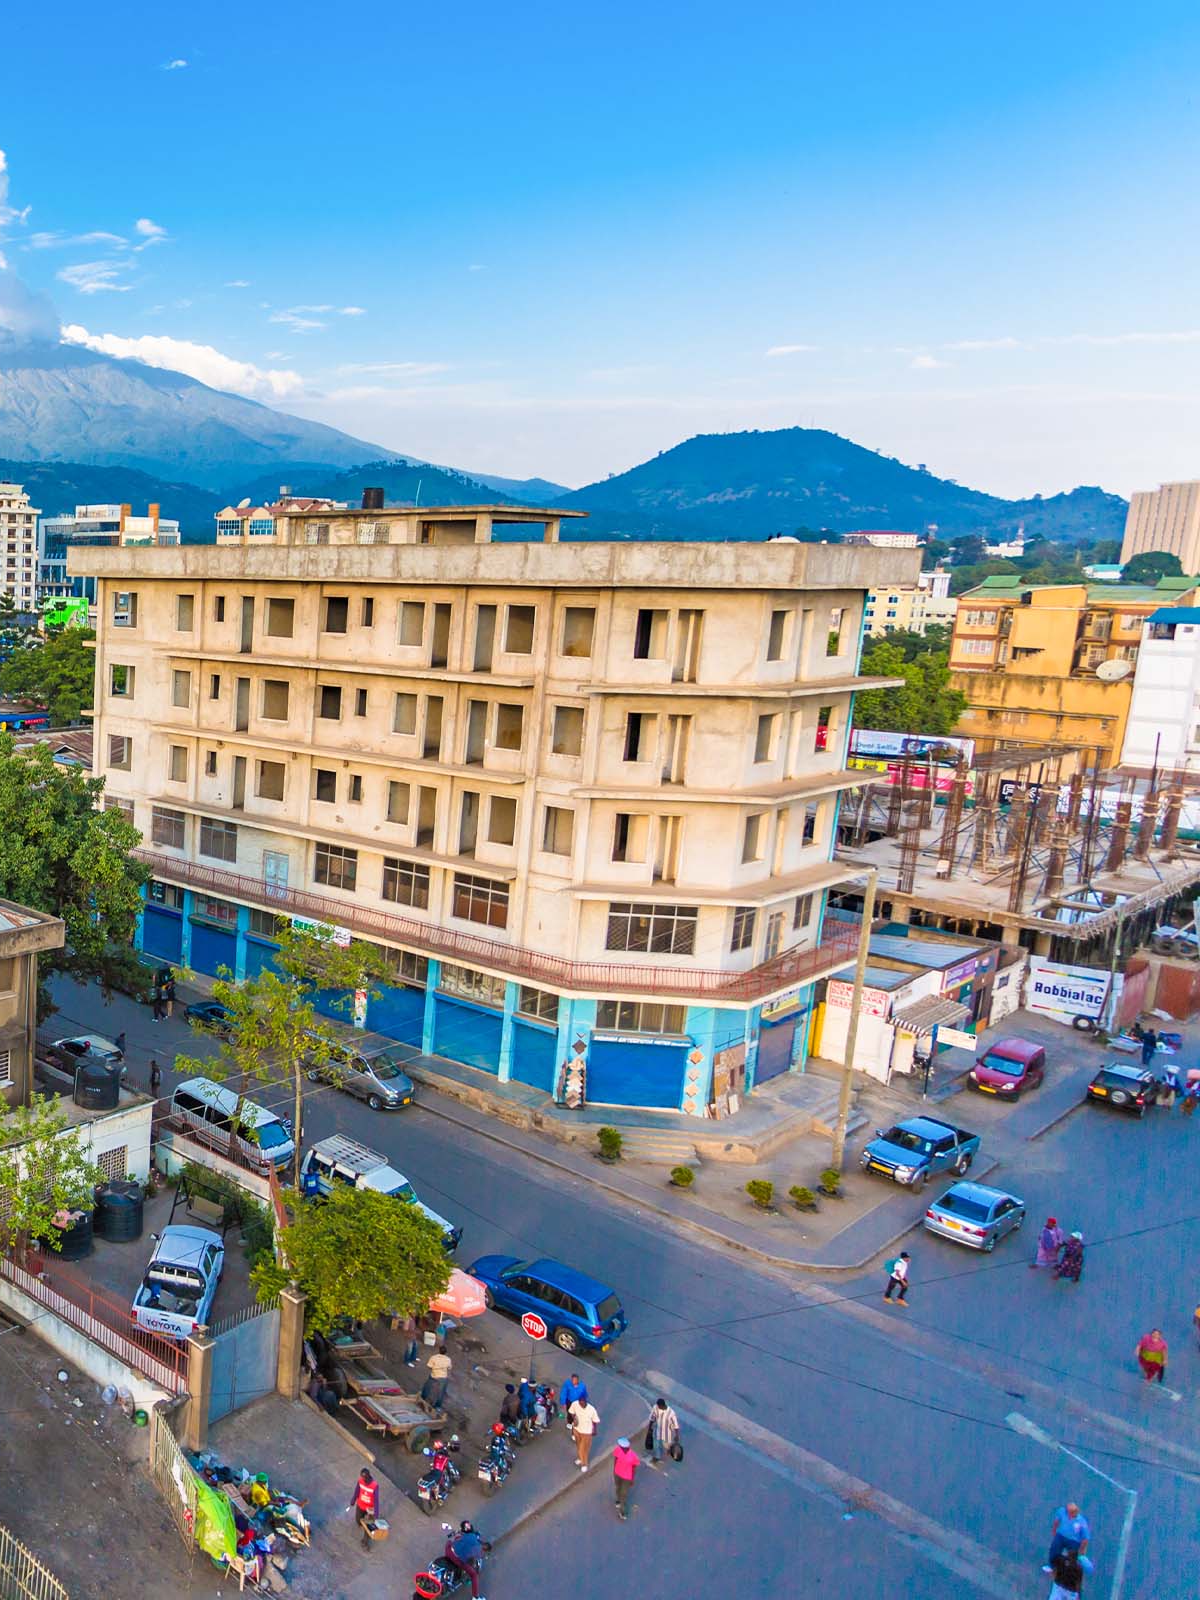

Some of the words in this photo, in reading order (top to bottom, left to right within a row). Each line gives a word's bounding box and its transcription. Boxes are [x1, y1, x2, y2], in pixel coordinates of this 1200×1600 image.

[1034, 982, 1103, 1005] Robbialac
[146, 1318, 182, 1333] TOYOTA
[523, 1318, 545, 1335] STOP
